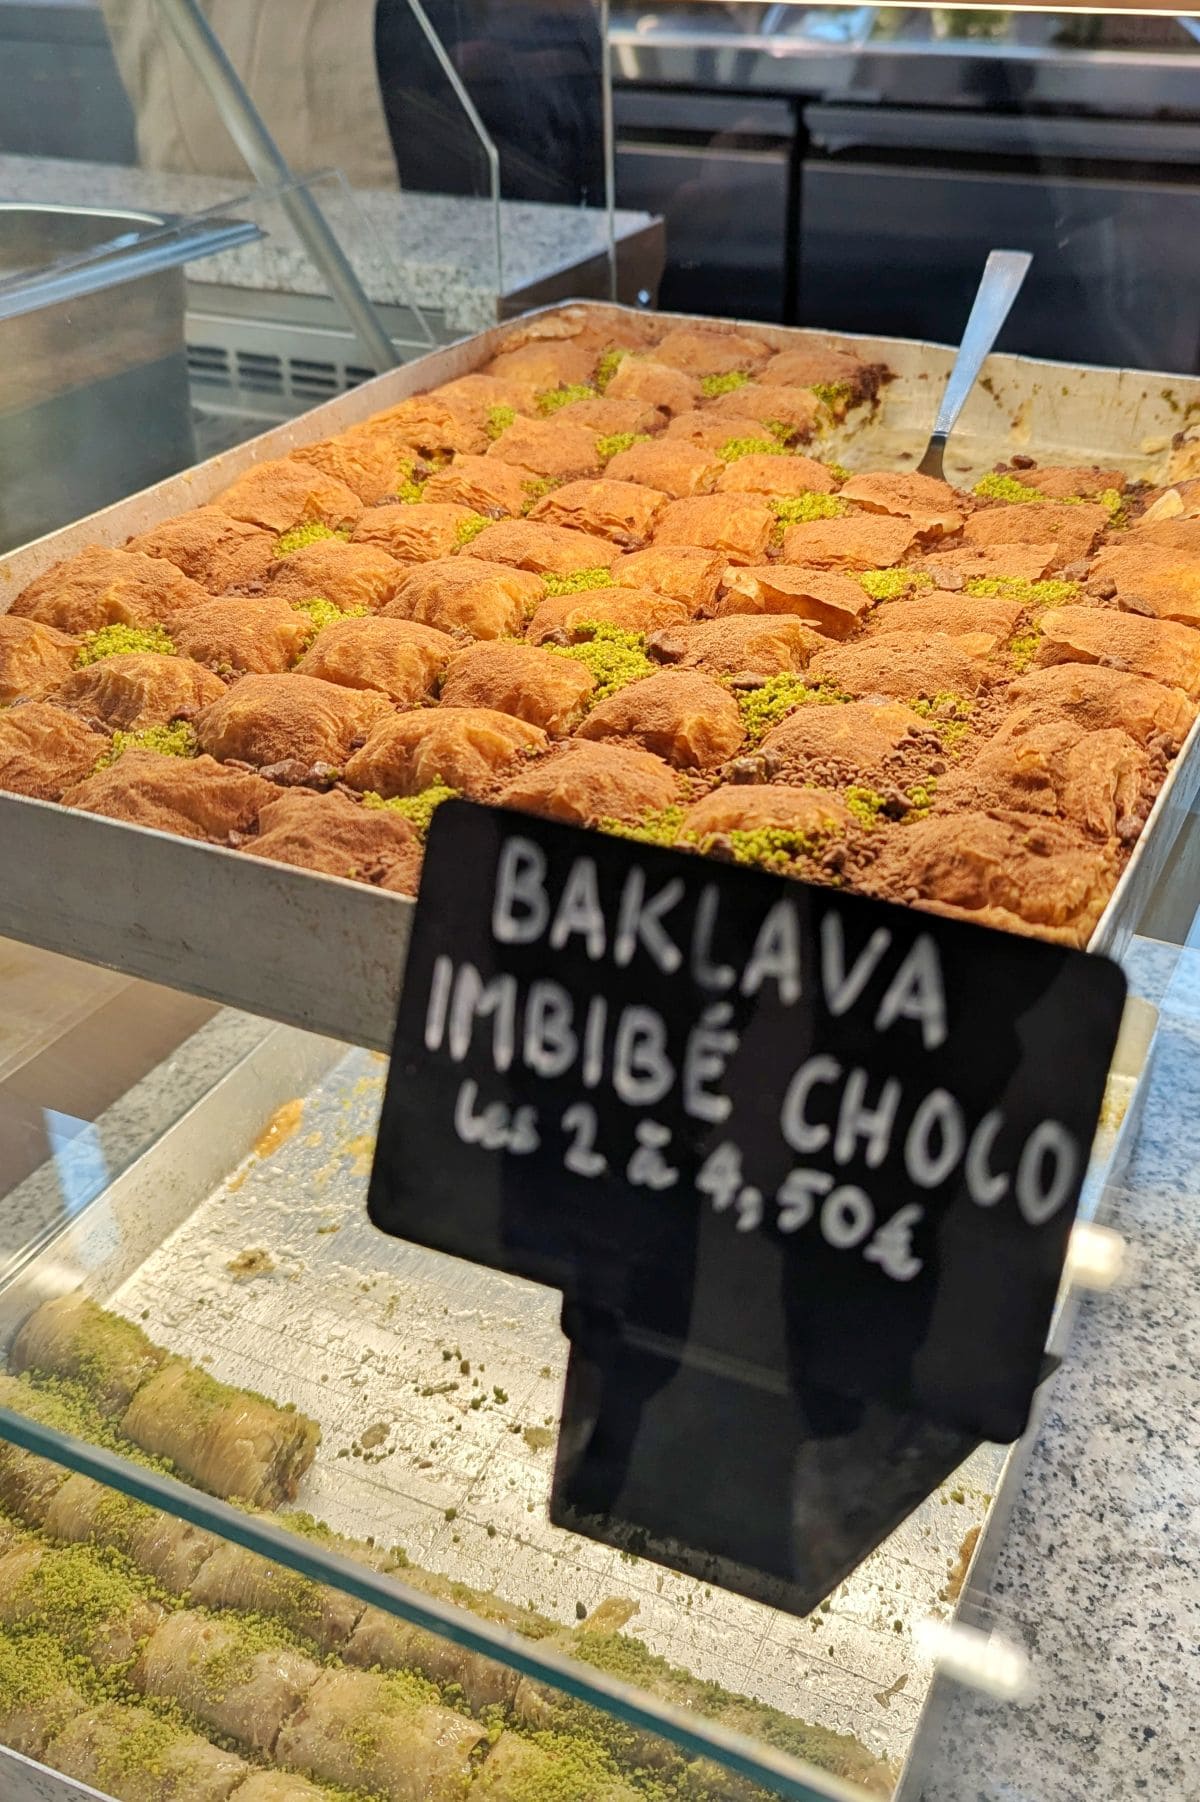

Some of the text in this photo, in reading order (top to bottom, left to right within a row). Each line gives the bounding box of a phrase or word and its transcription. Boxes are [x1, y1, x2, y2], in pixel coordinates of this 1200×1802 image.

[493, 836, 948, 1050] BAKLAVA
[425, 955, 1077, 1224] IMBIBÉ CHOCO
[562, 1102, 607, 1176] 2
